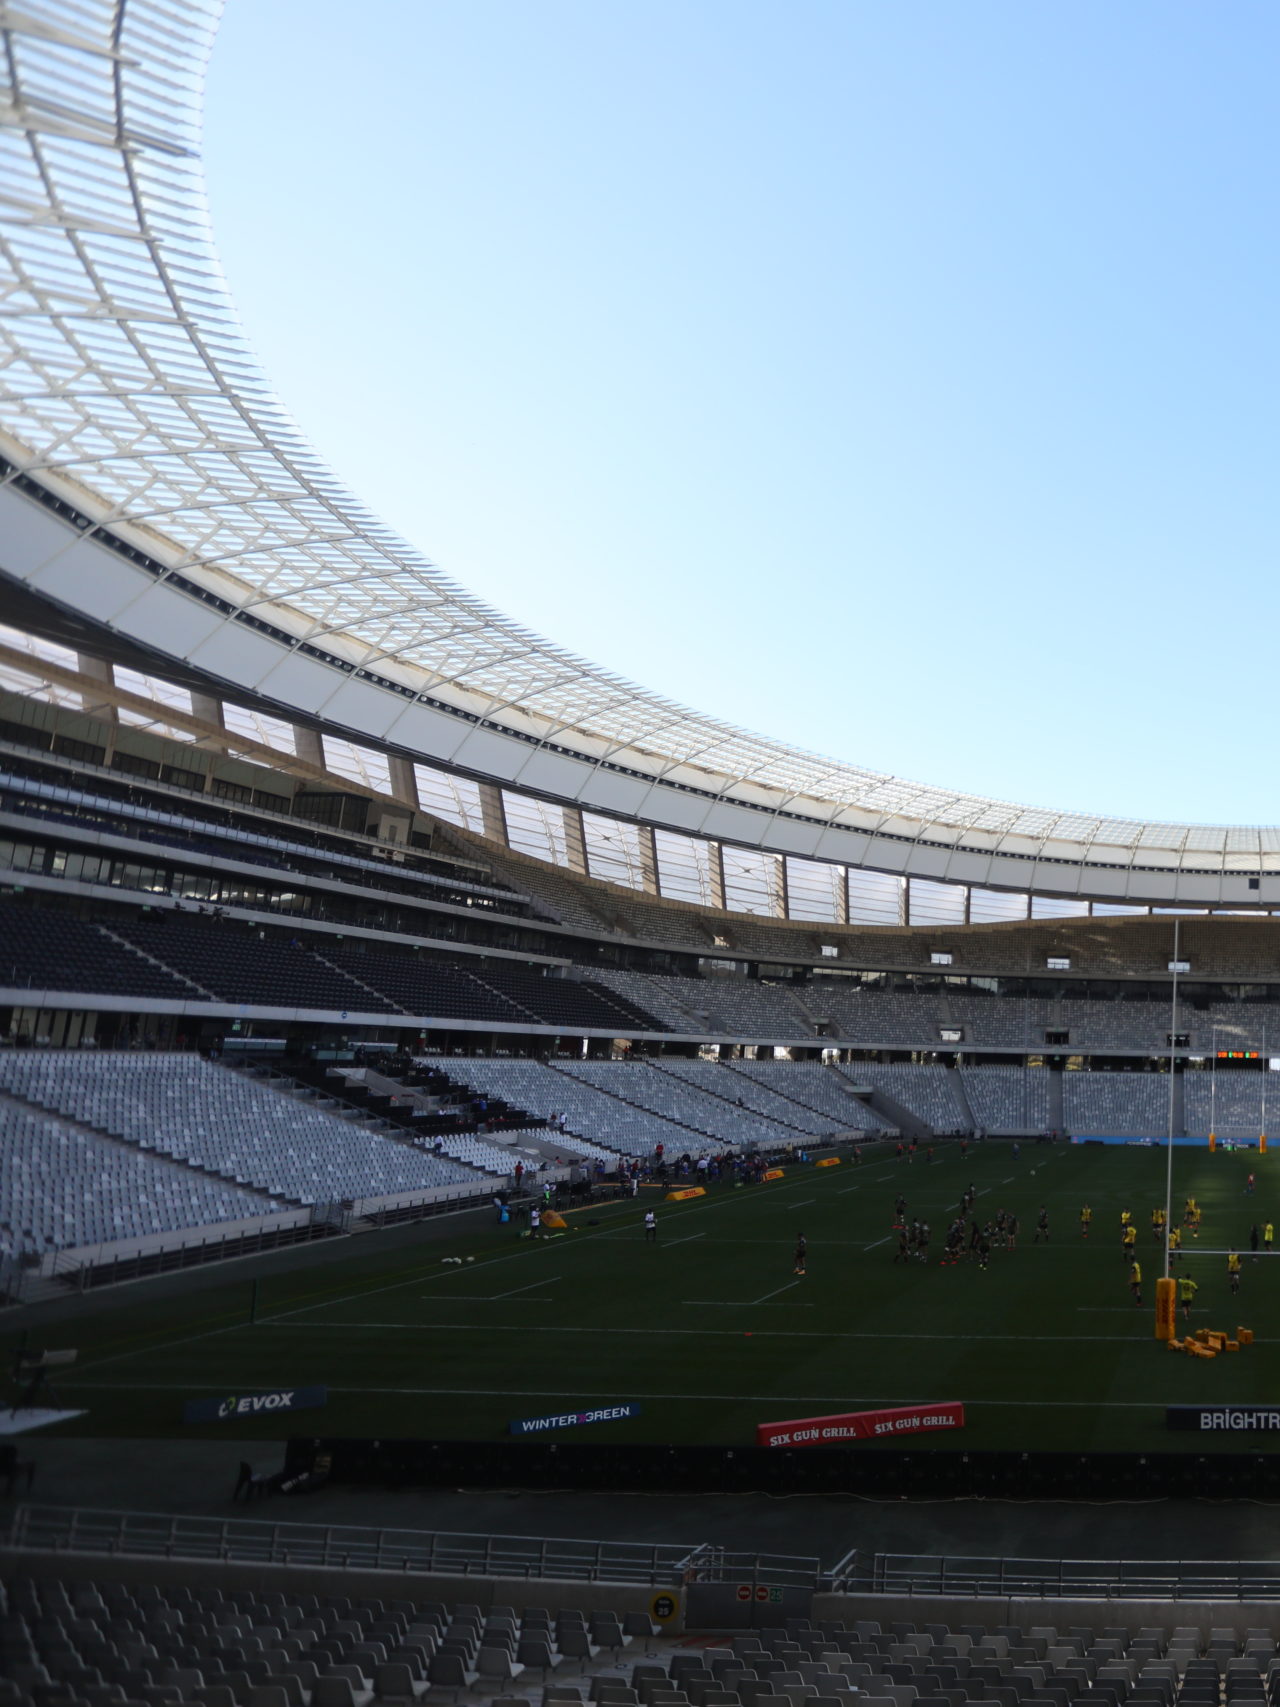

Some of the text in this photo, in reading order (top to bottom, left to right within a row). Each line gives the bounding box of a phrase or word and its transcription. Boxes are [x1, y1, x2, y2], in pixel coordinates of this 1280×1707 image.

[237, 1392, 294, 1413] EVOX
[875, 1415, 956, 1434] SIX GUN GRILL
[769, 1426, 857, 1447] SIX GUN GRILL
[658, 1607, 669, 1616] 25
